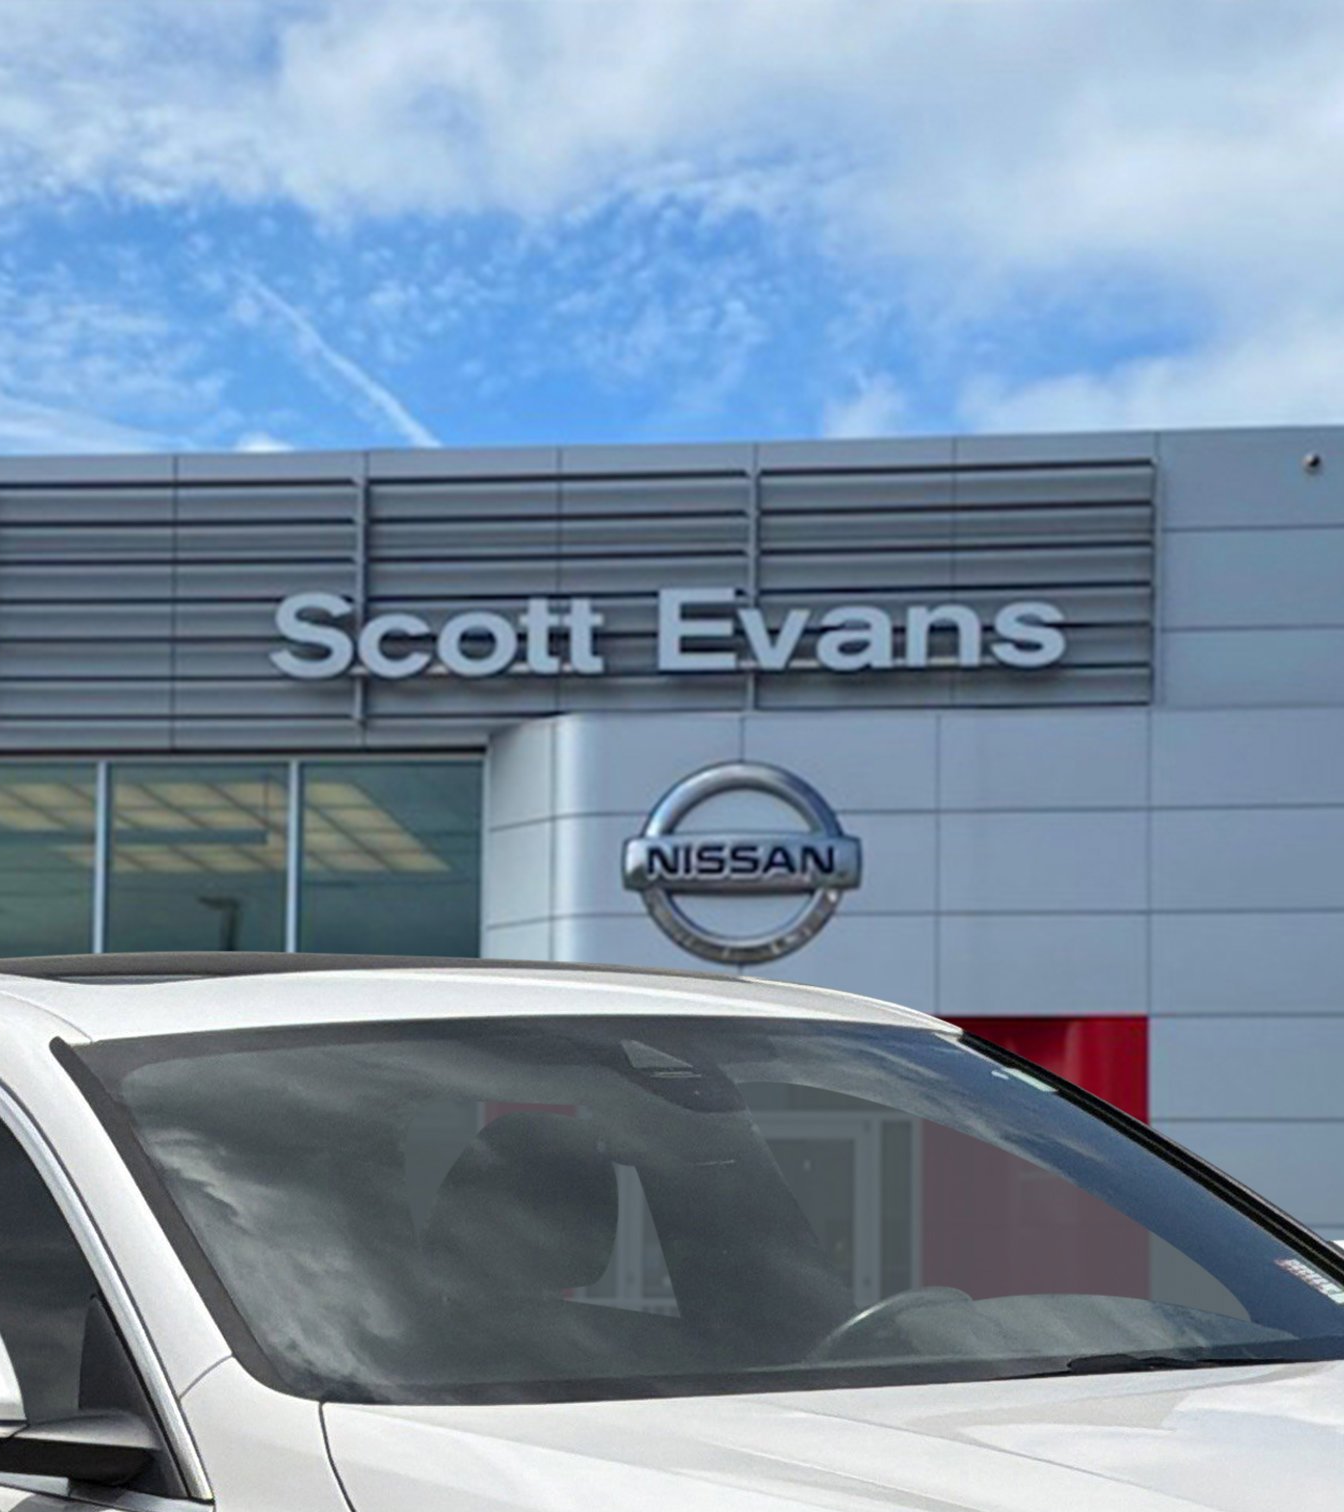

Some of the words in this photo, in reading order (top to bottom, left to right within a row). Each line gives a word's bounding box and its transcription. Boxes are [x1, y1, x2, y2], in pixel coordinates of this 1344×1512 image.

[270, 591, 605, 679] Scott
[658, 586, 1067, 673] Evans
[645, 846, 835, 875] NISSAN
